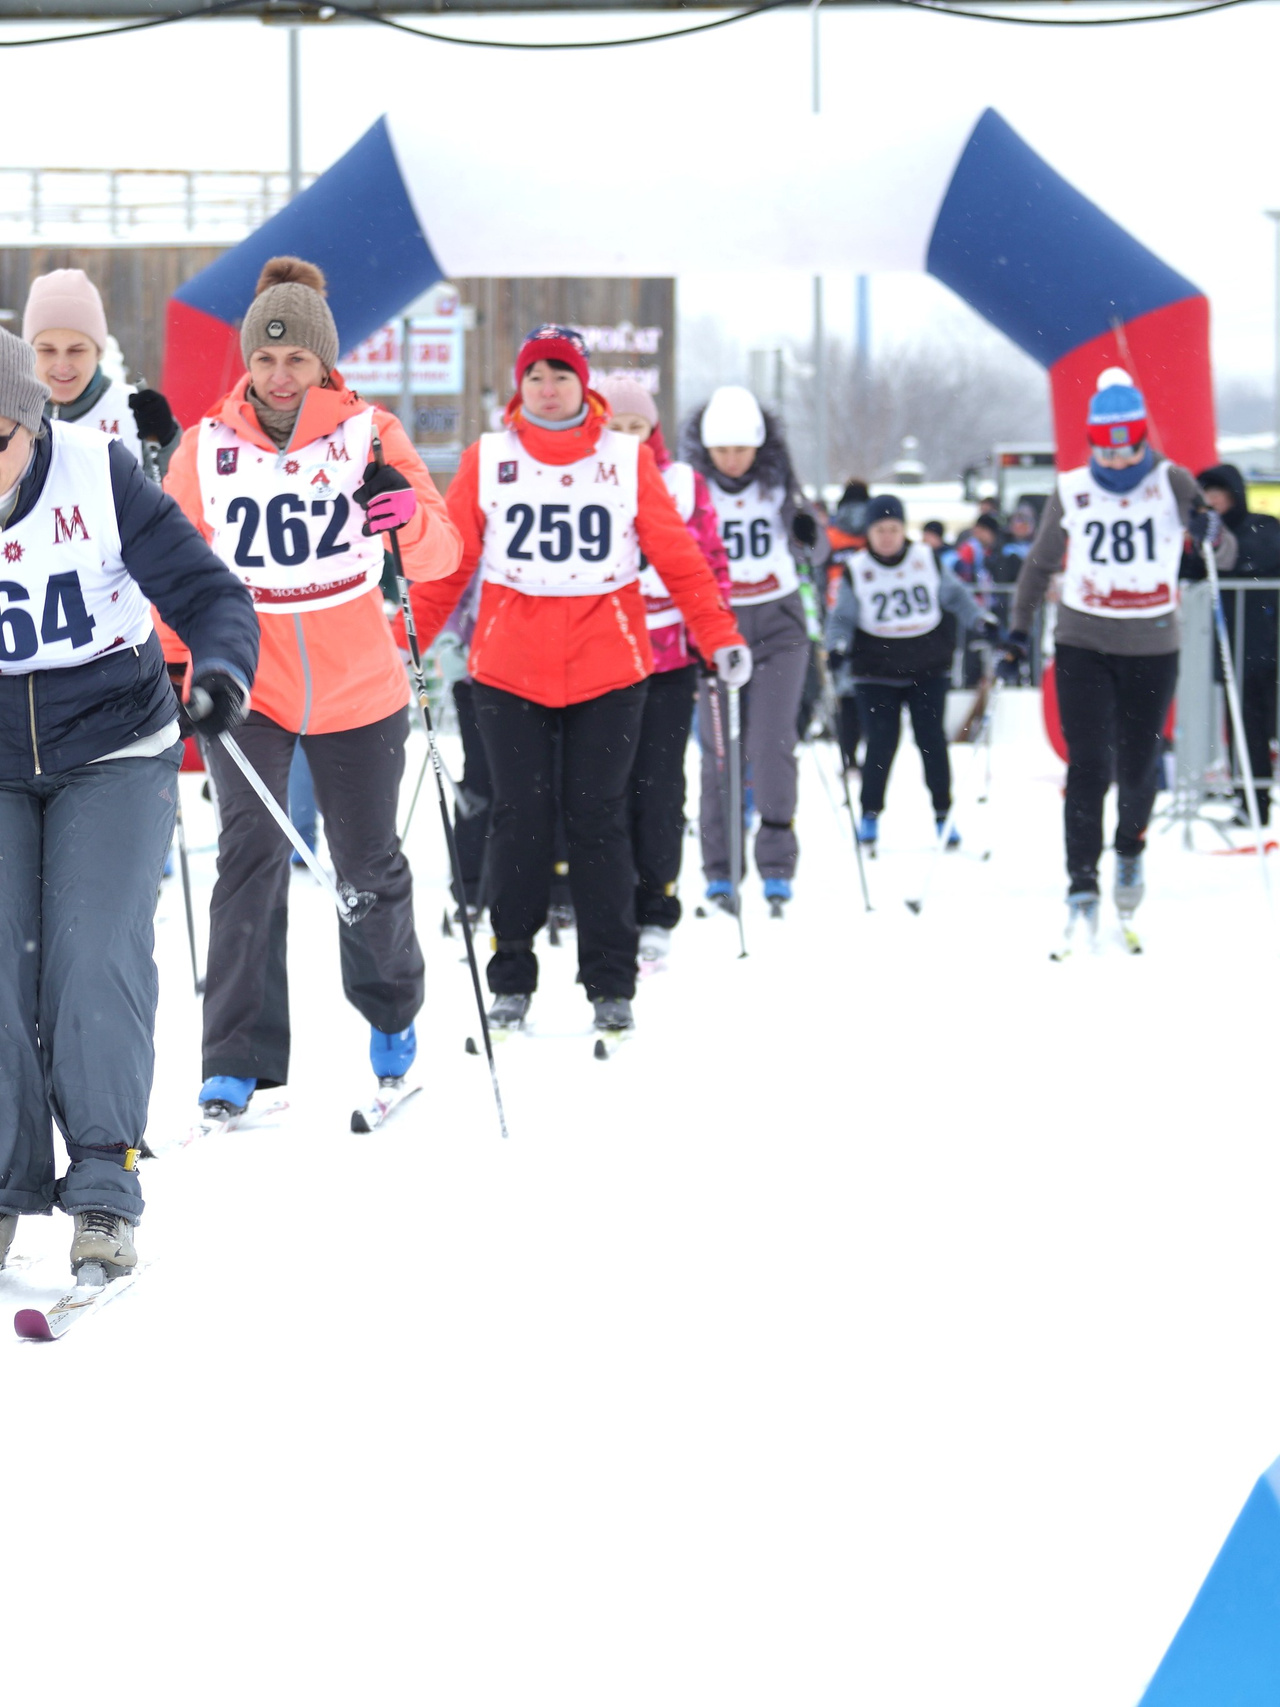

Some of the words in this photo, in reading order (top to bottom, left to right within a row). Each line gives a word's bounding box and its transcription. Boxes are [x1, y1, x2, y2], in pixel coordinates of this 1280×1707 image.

[226, 492, 352, 568] 262
[506, 503, 611, 563] 259
[1084, 518, 1156, 565] 281
[872, 584, 931, 623] 239
